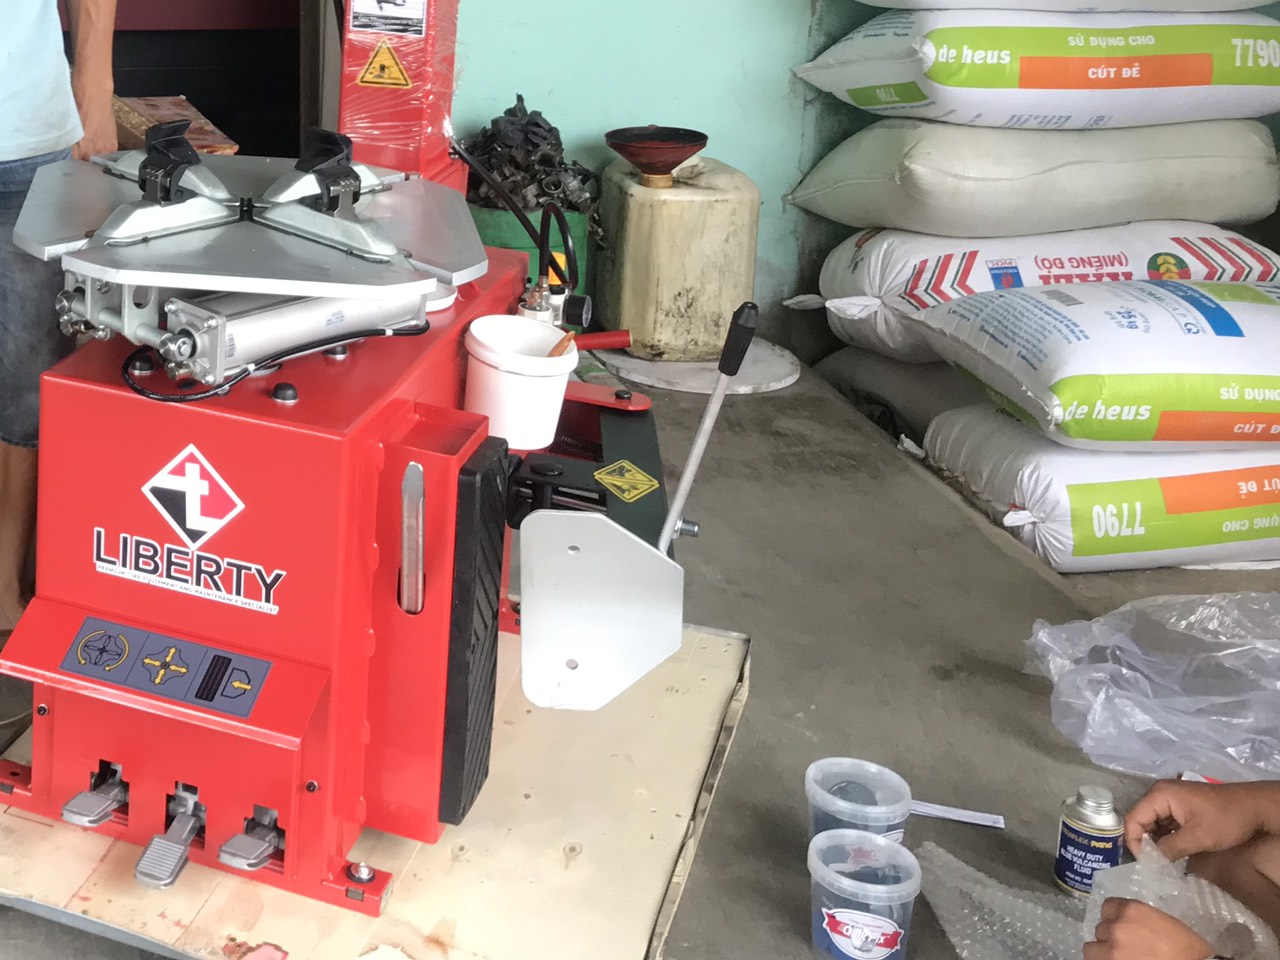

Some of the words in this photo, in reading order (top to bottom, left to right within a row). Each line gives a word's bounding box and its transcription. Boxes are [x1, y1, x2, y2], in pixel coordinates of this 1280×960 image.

[1068, 33, 1086, 46] SỬ
[1089, 35, 1125, 48] DỤNG
[1128, 35, 1156, 46] CHO
[938, 45, 958, 63] de
[961, 45, 1011, 65] heus
[1231, 38, 1280, 68] 7790
[1088, 64, 1119, 79] CÚT
[1220, 383, 1239, 400] SỬ
[1064, 401, 1089, 421] de
[1093, 400, 1152, 421] heus
[1233, 422, 1266, 434] CÚT
[1092, 502, 1146, 538] 7790
[1222, 519, 1249, 533] CHO
[94, 527, 286, 605] LIBERTY
[1067, 845, 1085, 858] HEAVY
[1086, 853, 1103, 862] DUTY
[1072, 855, 1111, 869] VULCANIZING
[1073, 864, 1092, 875] FLUID
